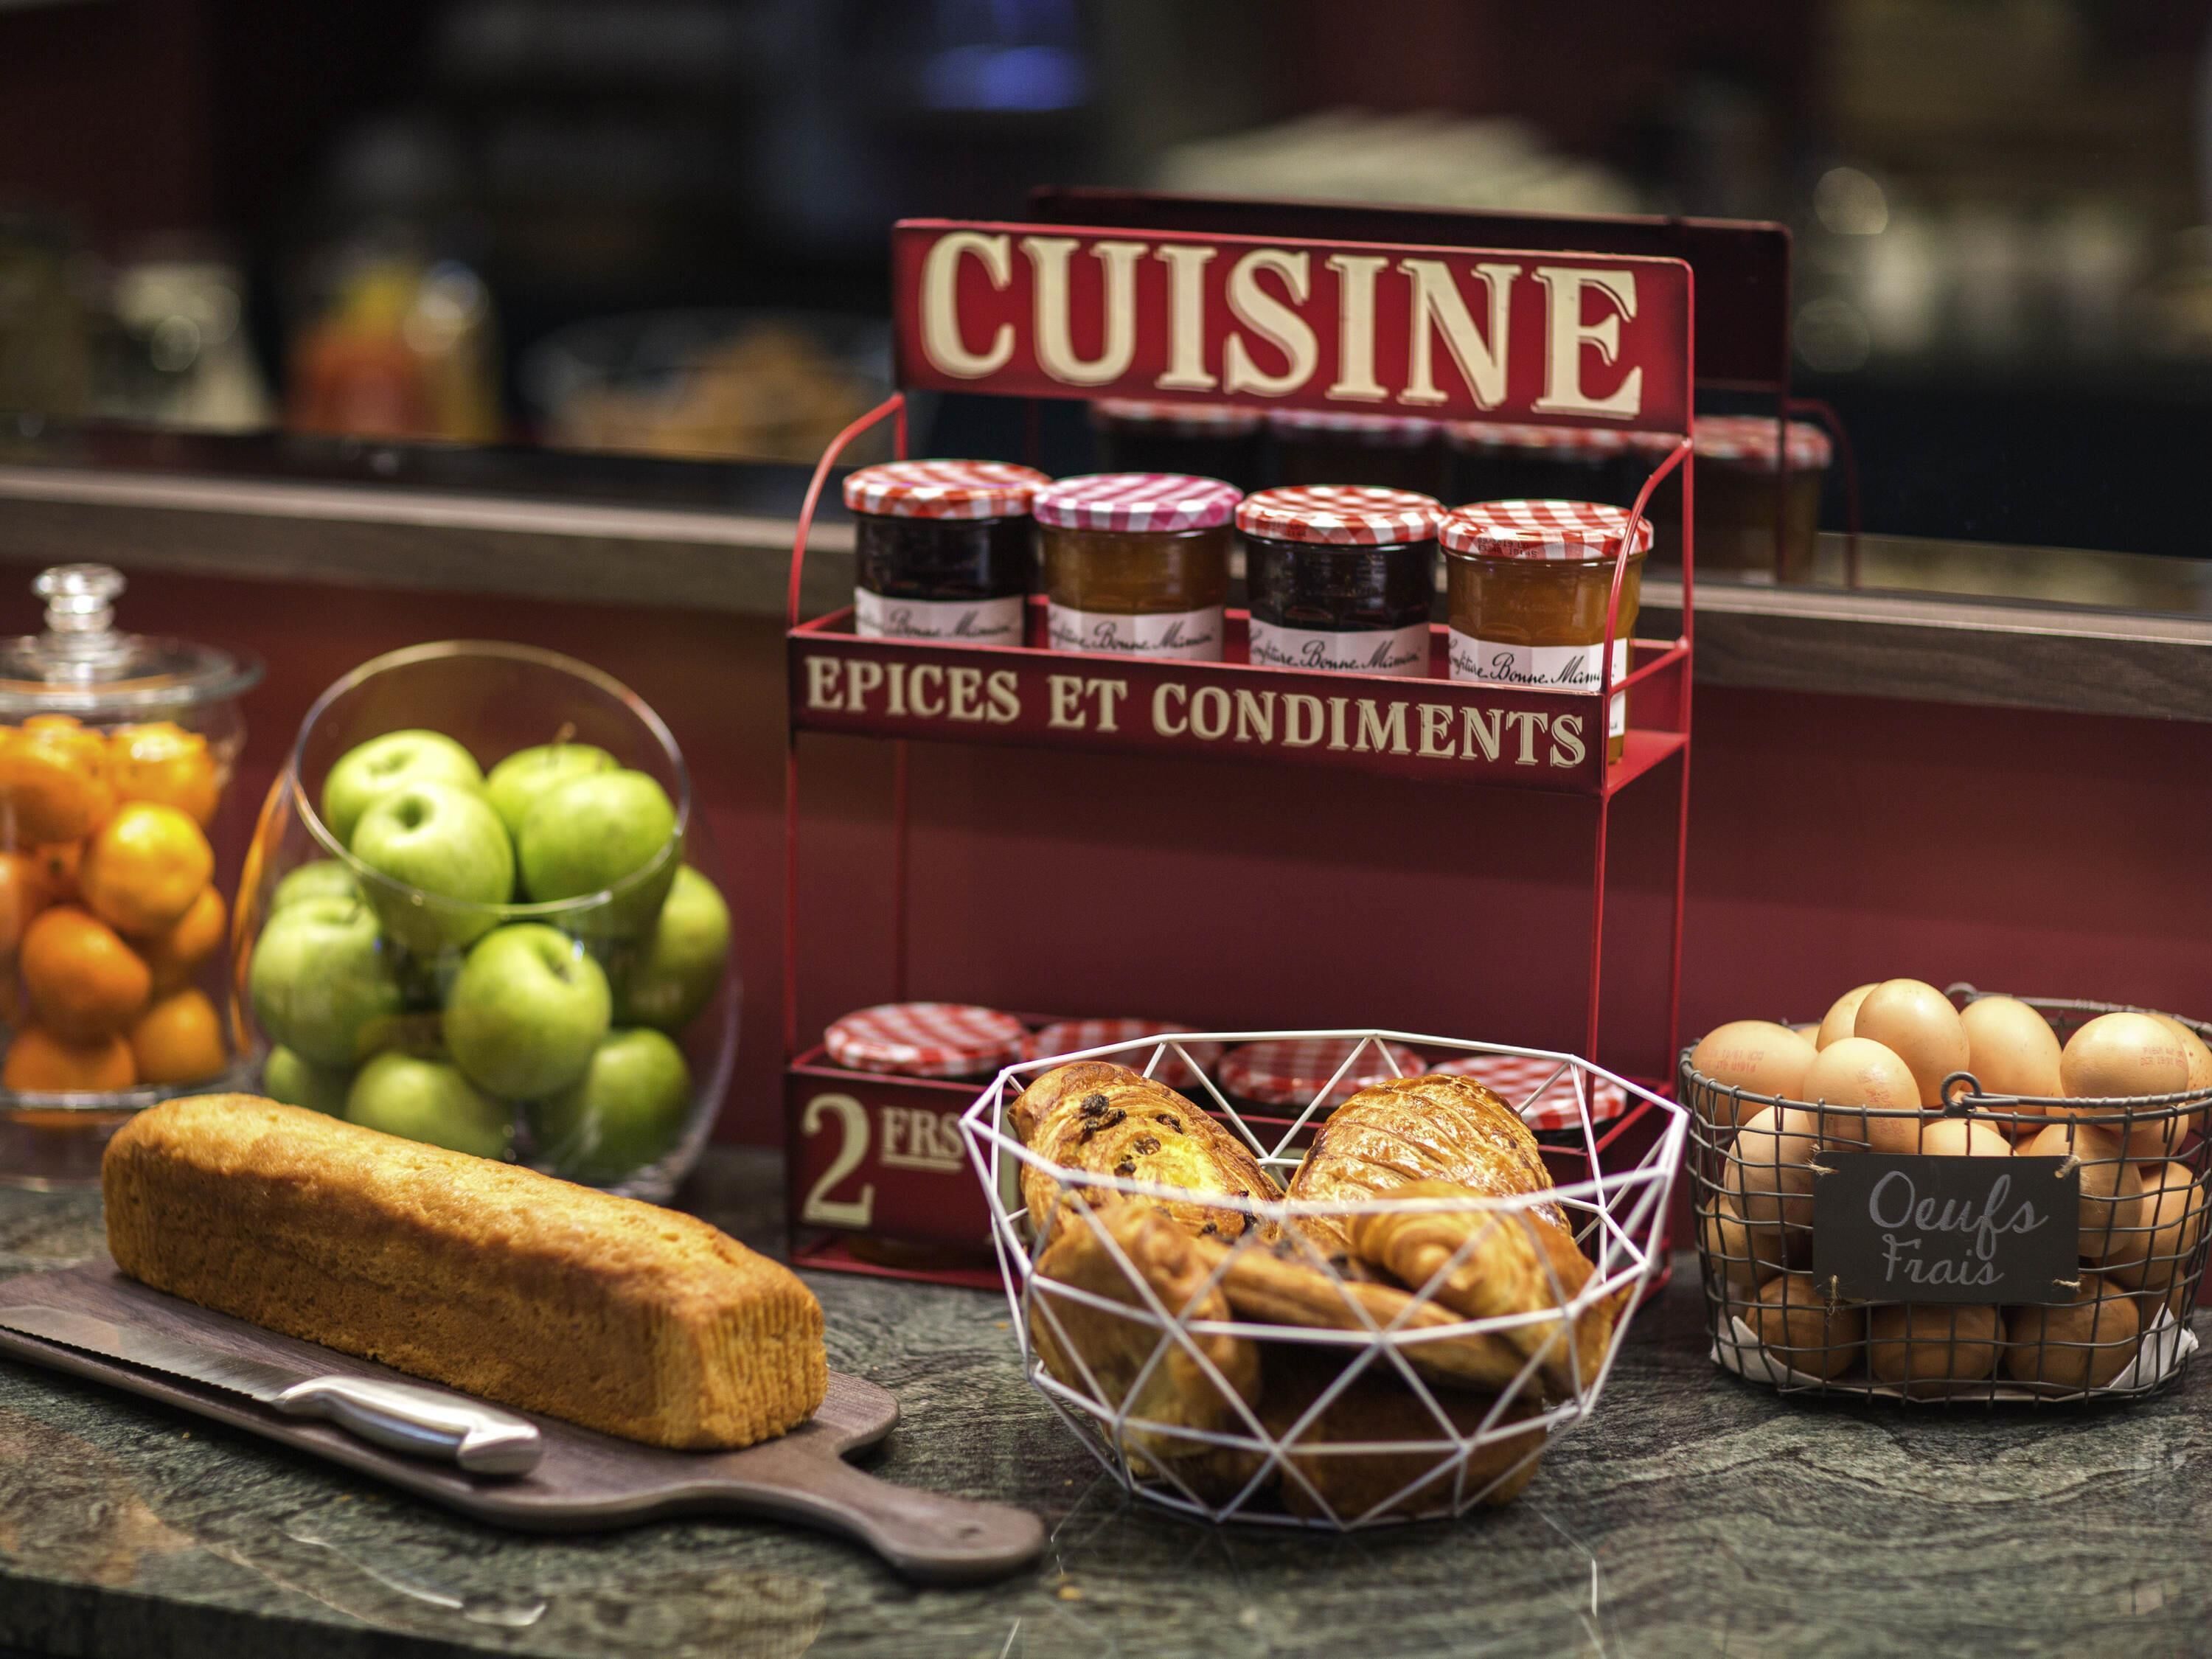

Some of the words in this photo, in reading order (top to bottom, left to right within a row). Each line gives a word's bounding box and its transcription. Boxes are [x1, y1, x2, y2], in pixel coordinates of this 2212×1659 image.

[919, 232, 1644, 420] CUISINE
[1300, 640, 1360, 669] Bonne
[1490, 652, 1548, 684] Bonne
[1551, 655, 1615, 684] Mam
[805, 655, 1021, 724] EPICES
[1048, 674, 1127, 732] ET
[1152, 682, 1586, 768] CONDIMENTS
[801, 1093, 875, 1228] 2
[880, 1106, 967, 1159] FRS
[1870, 1170, 2048, 1260] Oeufs
[1882, 1234, 2006, 1286] Frais
